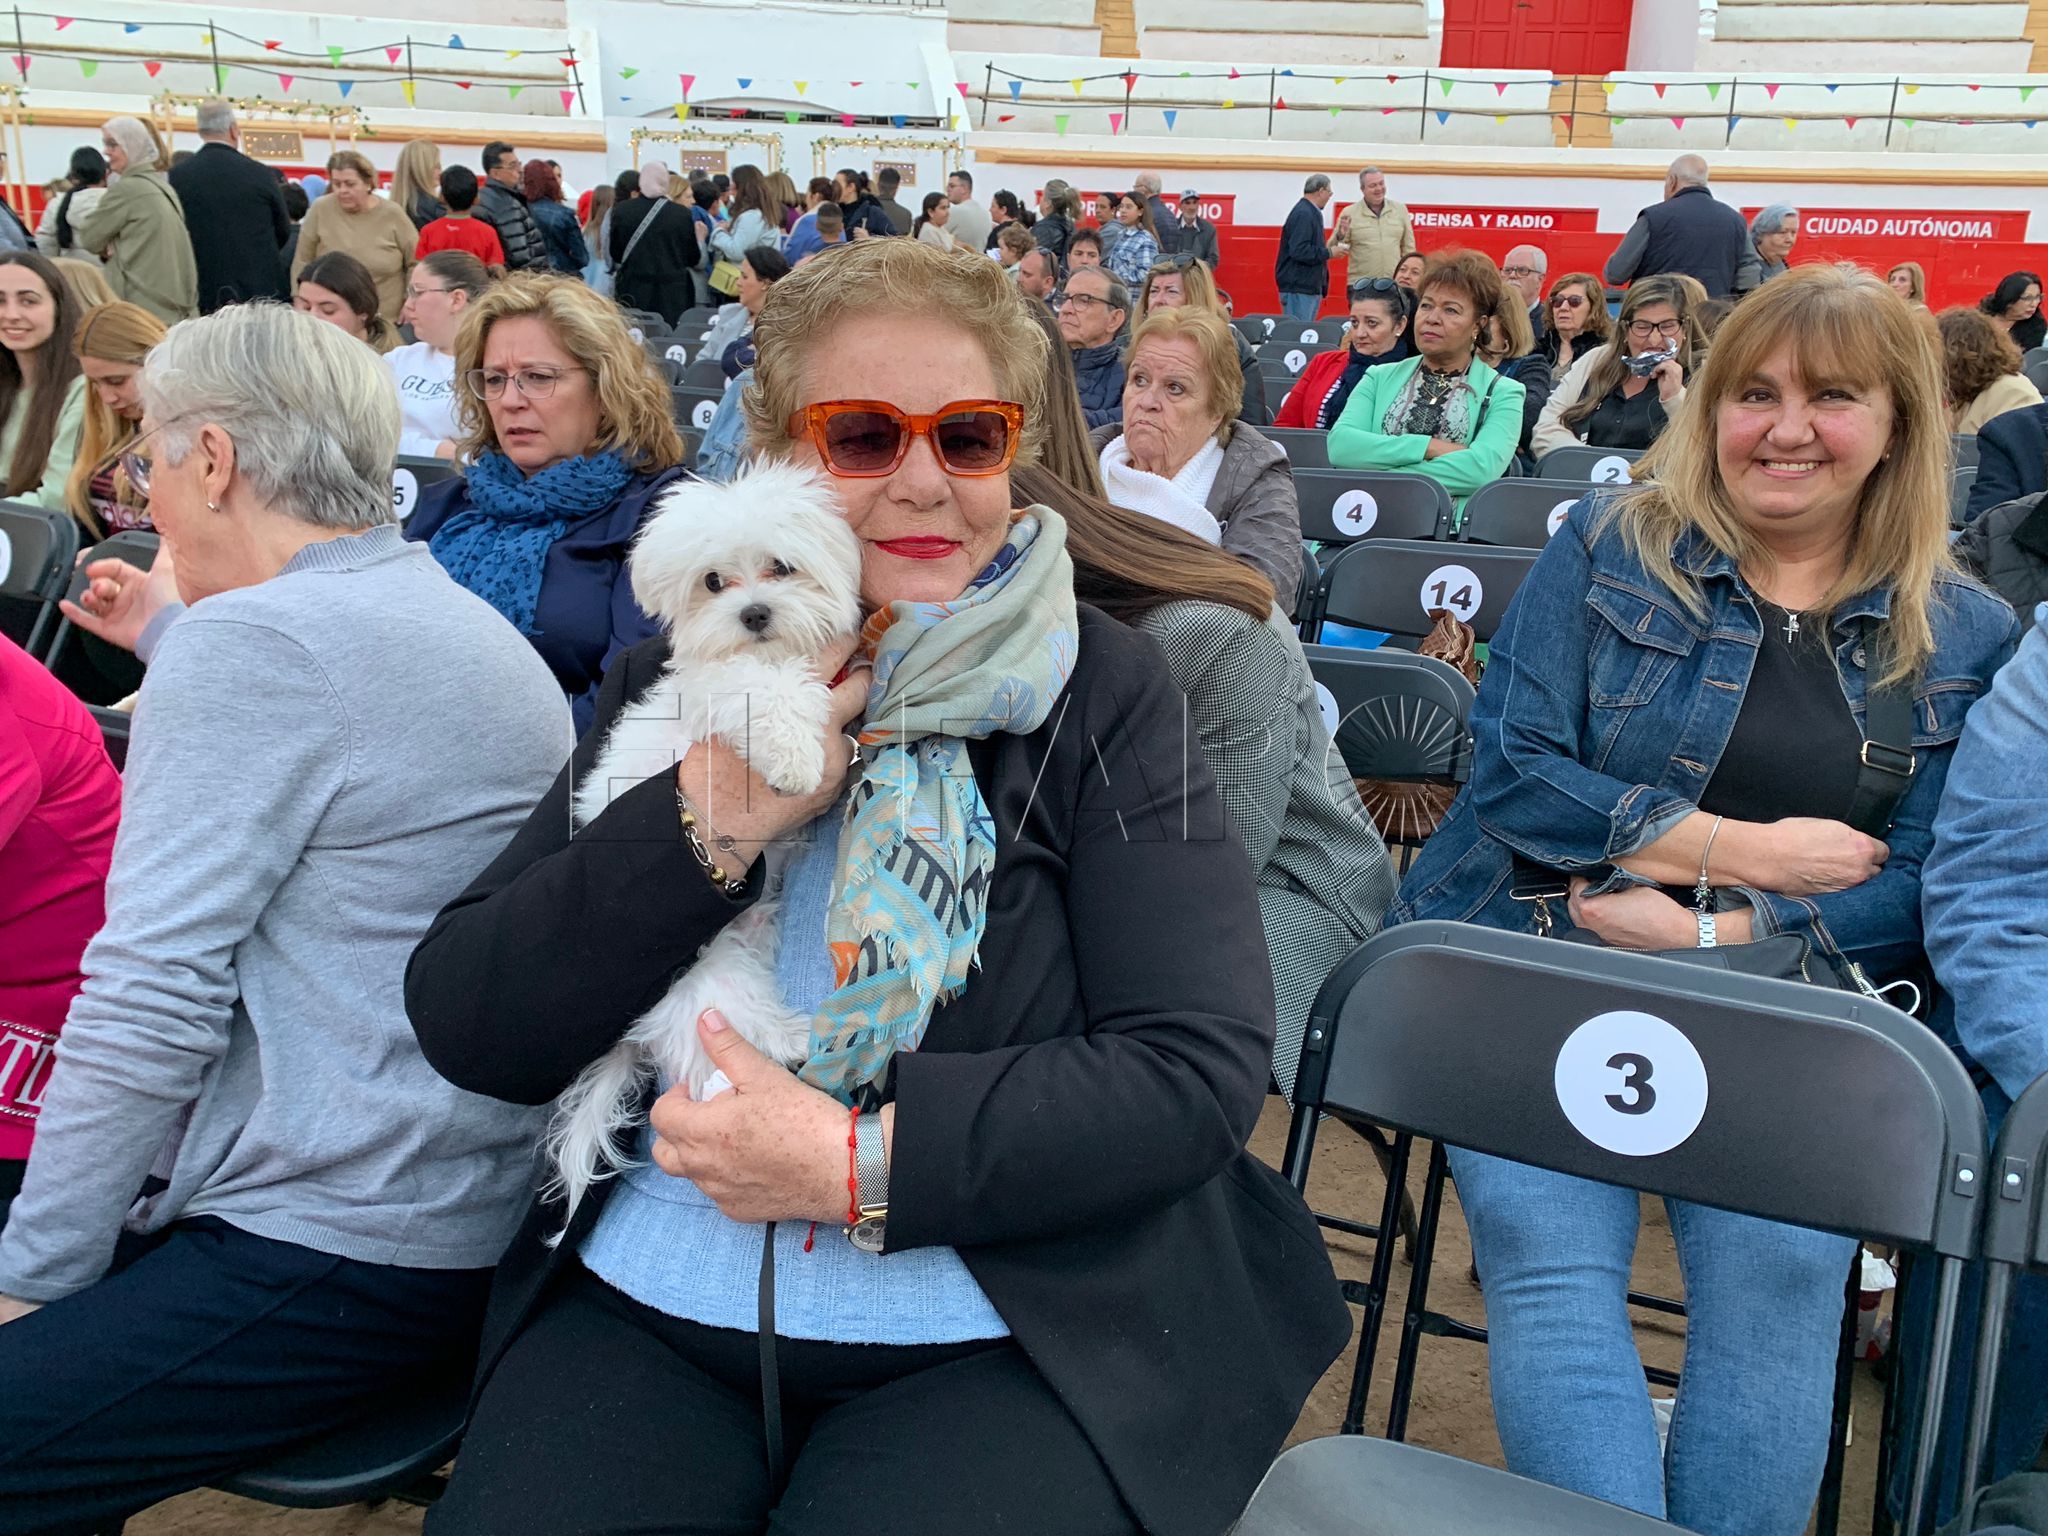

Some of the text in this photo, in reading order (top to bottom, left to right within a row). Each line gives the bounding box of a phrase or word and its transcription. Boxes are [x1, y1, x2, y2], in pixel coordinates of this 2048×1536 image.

[1480, 214, 1492, 227] Y
[1496, 214, 1554, 229] RADIO
[1806, 217, 1992, 238] CIUDAD AUTÓNOMA
[1306, 334, 1313, 342] 7
[1292, 356, 1299, 366] 1
[702, 410, 712, 424] 8
[1604, 467, 1620, 484] 2
[1346, 503, 1363, 524] 4
[1430, 580, 1473, 611] 14
[1604, 1052, 1657, 1116] 3
